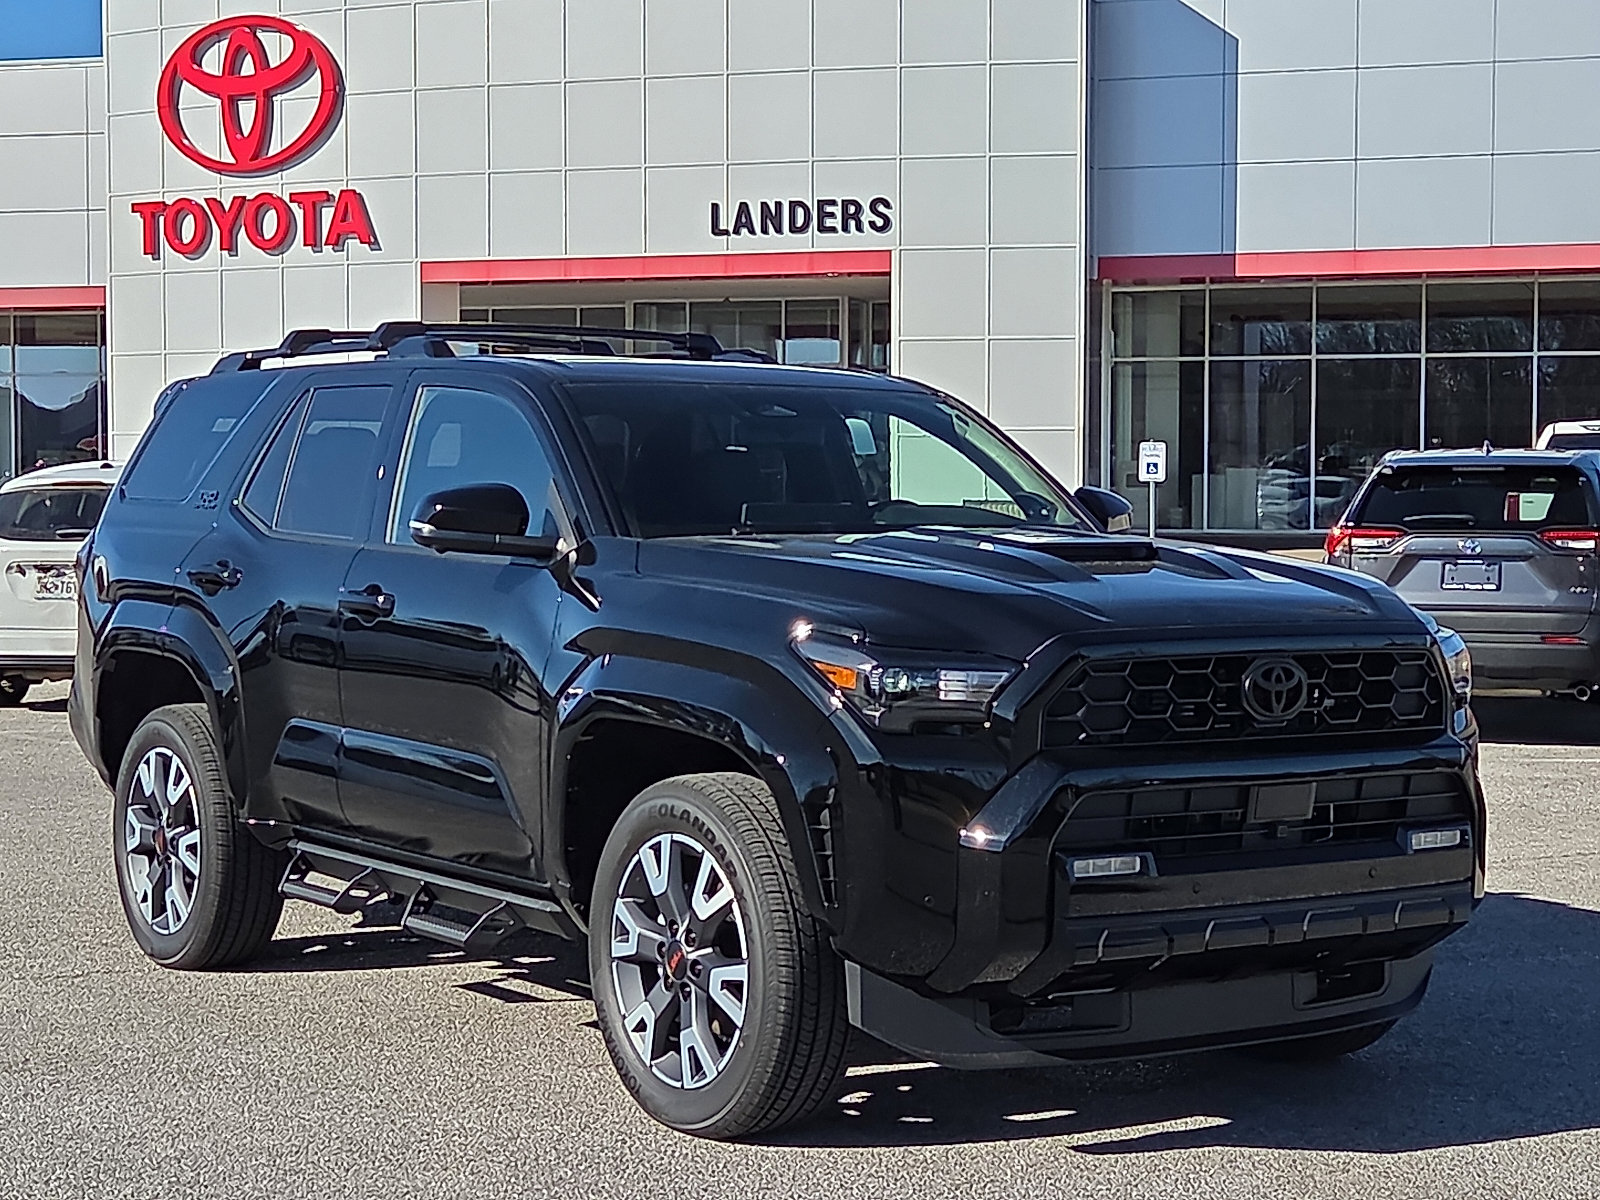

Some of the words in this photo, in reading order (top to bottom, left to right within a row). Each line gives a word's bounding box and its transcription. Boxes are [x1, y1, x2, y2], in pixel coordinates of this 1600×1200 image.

[131, 189, 377, 258] TOYOTA
[711, 197, 893, 236] LANDERS
[642, 803, 737, 877] EOLANDAR
